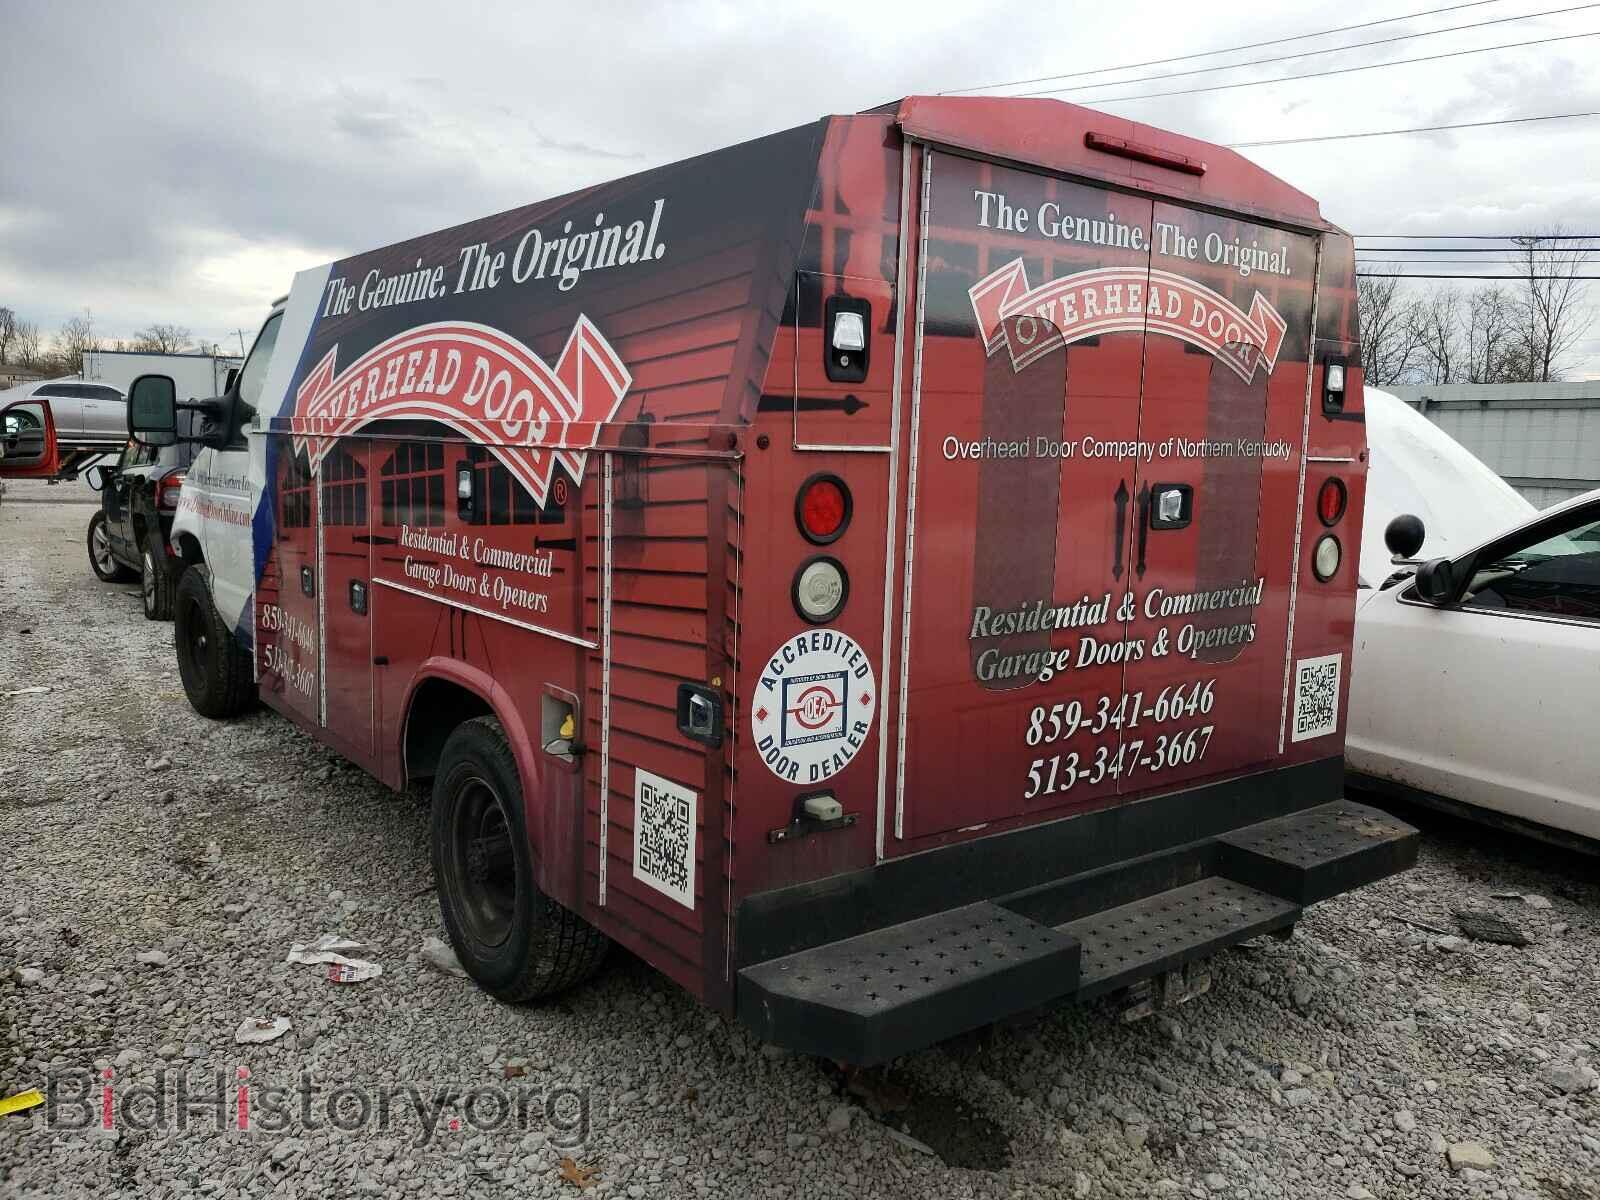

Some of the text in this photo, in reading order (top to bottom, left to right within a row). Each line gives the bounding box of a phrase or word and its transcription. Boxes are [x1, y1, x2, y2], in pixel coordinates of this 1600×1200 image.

[322, 198, 666, 318] The Genuine. The Original.
[974, 190, 1291, 277] The Genuine. The Original.
[1015, 284, 1254, 365] OVERHEAD DOOR
[463, 355, 550, 464] DOOR
[943, 436, 1292, 463] Overhead Door Company of Northern Kentucky
[400, 524, 553, 577] Residential & Commercial
[404, 555, 548, 613] Garage Doors & Openers
[969, 578, 1264, 640] Residential & Commercial
[760, 632, 869, 692] ACCREDITED
[976, 621, 1256, 682] Garage Doors & Openers
[1026, 679, 1217, 746] 859-341-6646
[758, 720, 868, 782] DOOR DEALER
[1024, 726, 1215, 800] 513-347-3667
